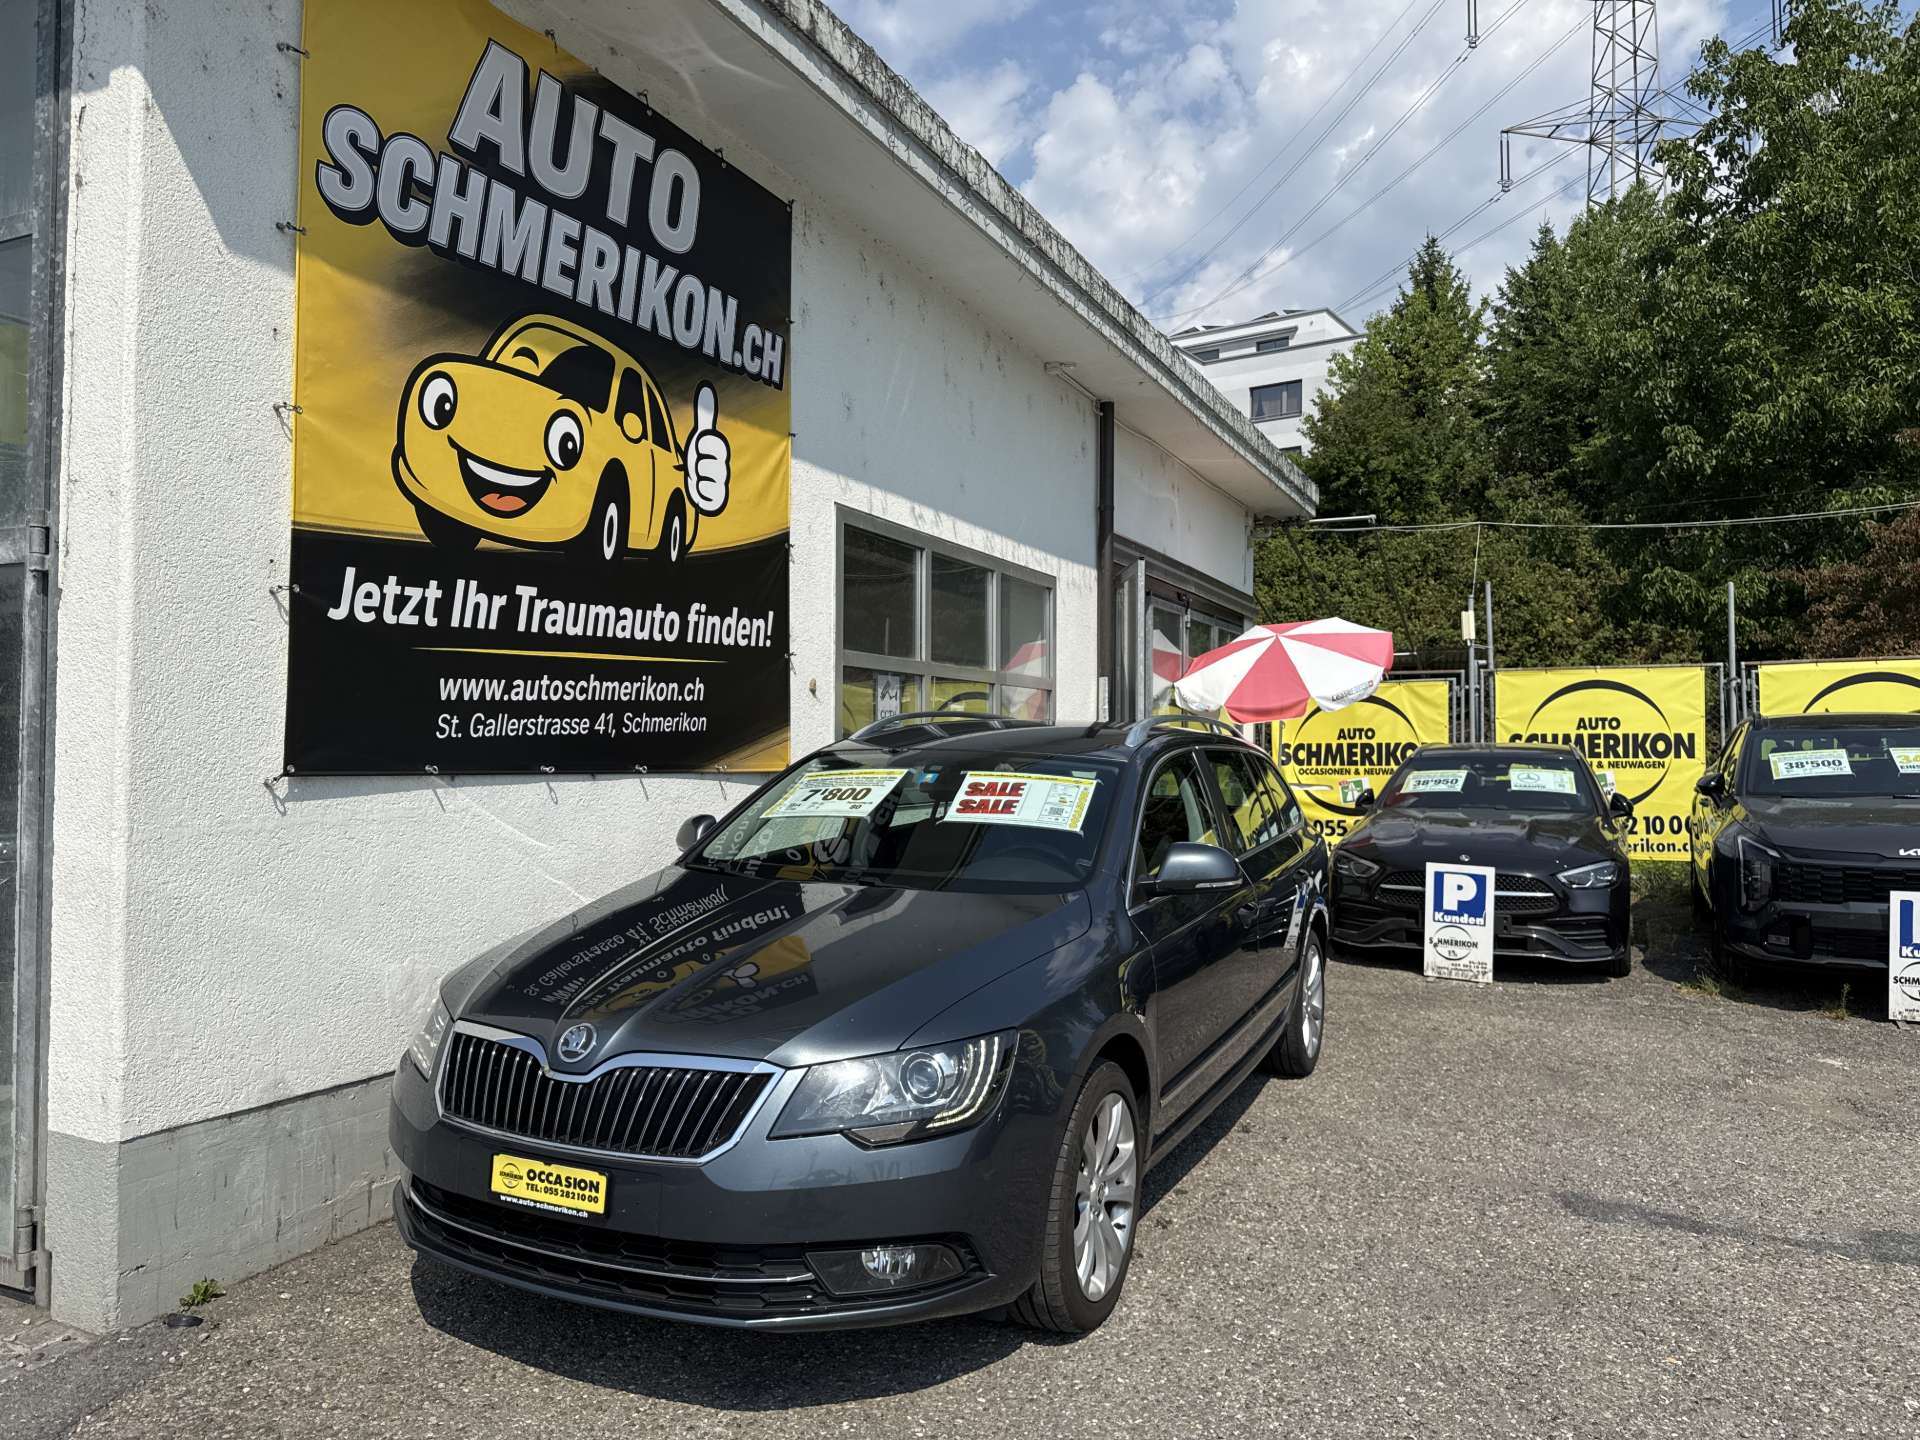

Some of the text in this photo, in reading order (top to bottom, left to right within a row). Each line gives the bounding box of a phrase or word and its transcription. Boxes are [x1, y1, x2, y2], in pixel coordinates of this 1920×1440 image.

[448, 38, 700, 254] AUTO
[316, 104, 785, 386] SCHMERIKON.CH
[327, 566, 775, 648] Jetzt Ihr Traumauto finden!
[438, 674, 706, 703] www.autoschmerikon.ch
[435, 712, 708, 739] St. Gallerstrasse 41, Schmerikon
[1576, 717, 1621, 730] AUTO
[1337, 728, 1376, 740] AUTO
[1280, 742, 1419, 766] SCHMERIKO
[1298, 767, 1395, 776] OCCASIONEN & NEUWA
[1596, 761, 1604, 769] &
[1607, 760, 1666, 769] NEUWAGEN
[1784, 759, 1843, 770] 38'500
[964, 782, 1027, 797] SALE
[1412, 778, 1459, 787] 38'950
[802, 787, 873, 801] 7'800
[956, 799, 1020, 815] SALE
[1312, 820, 1348, 836] 055
[1442, 873, 1477, 911] P
[1434, 911, 1485, 926] Kunden
[525, 1182, 543, 1193] TEL:
[526, 1168, 600, 1194] OCCASION
[499, 1194, 589, 1219] www.auto-schmerikon.ch
